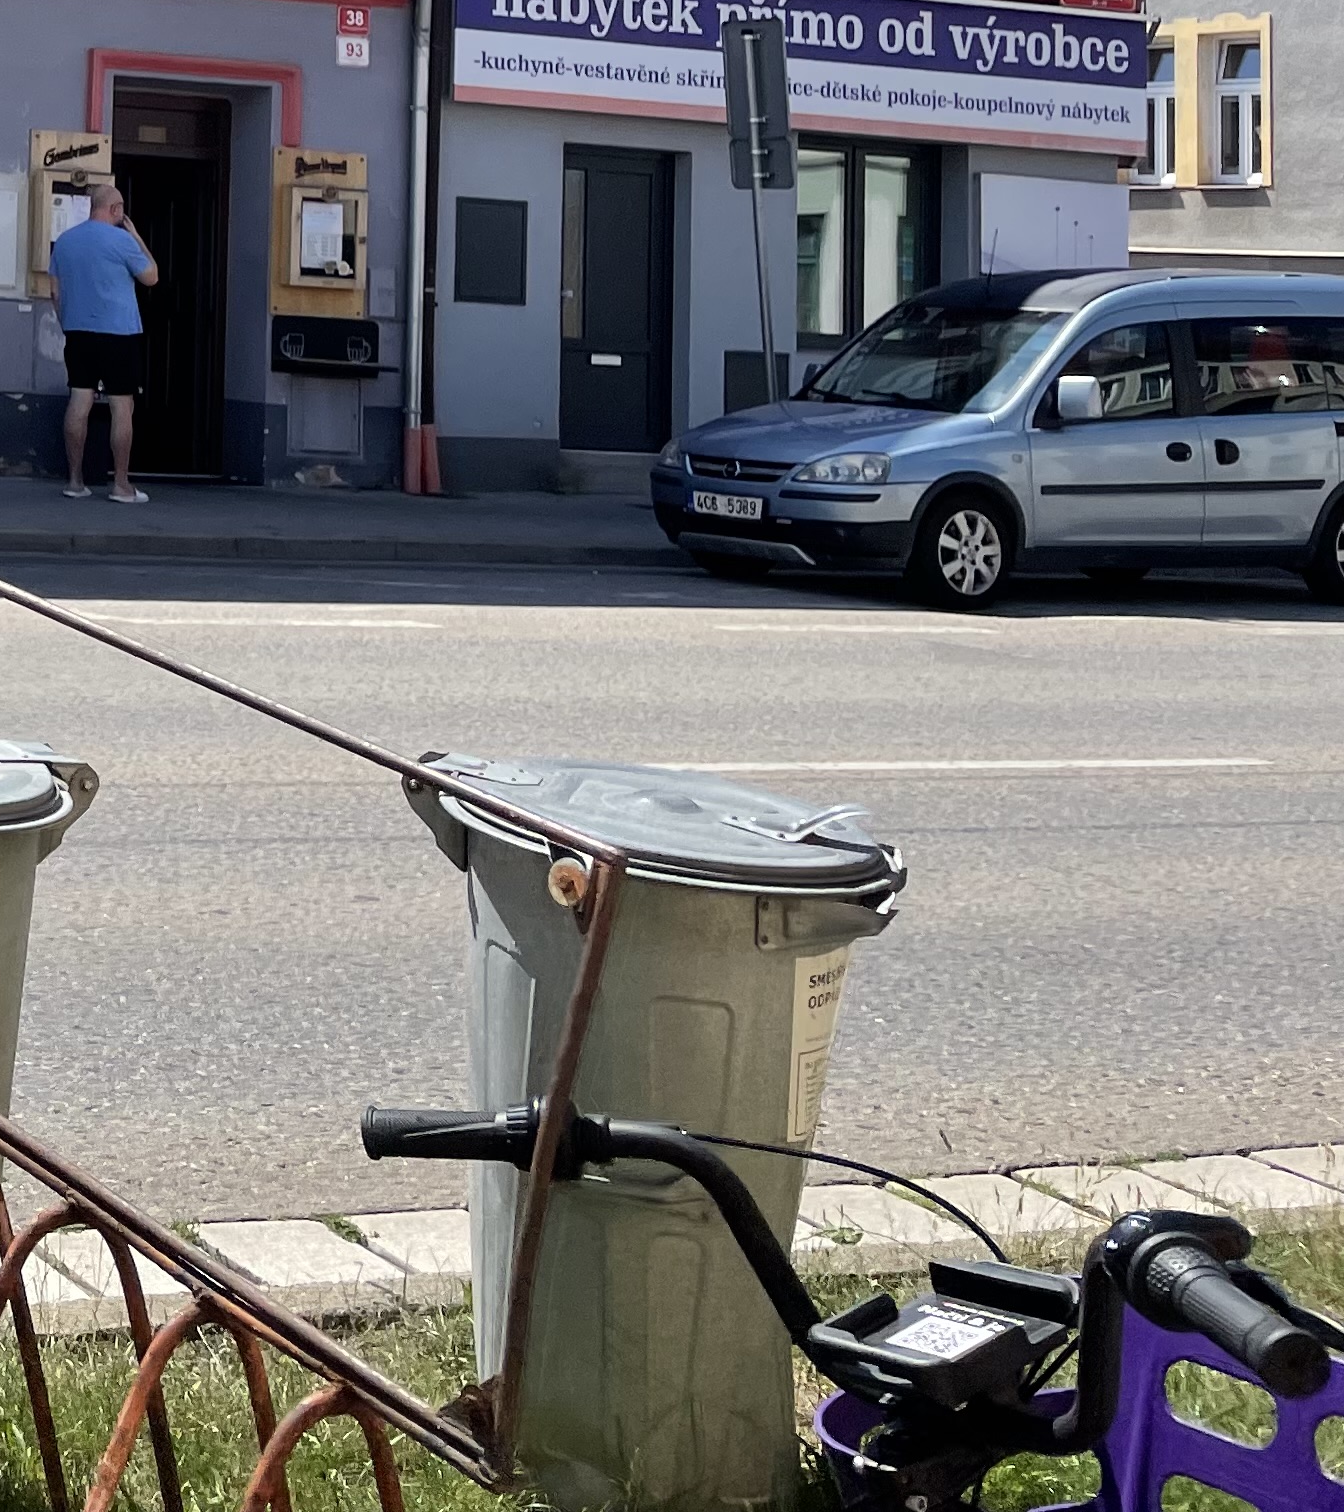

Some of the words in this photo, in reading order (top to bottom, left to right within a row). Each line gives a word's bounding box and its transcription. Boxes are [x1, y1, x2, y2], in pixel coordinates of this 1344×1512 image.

[346, 9, 364, 26] 38
[346, 42, 363, 57] 93
[878, 10, 936, 57] od
[948, 15, 1130, 74] výrobce
[1060, 98, 1132, 125] nábytek
